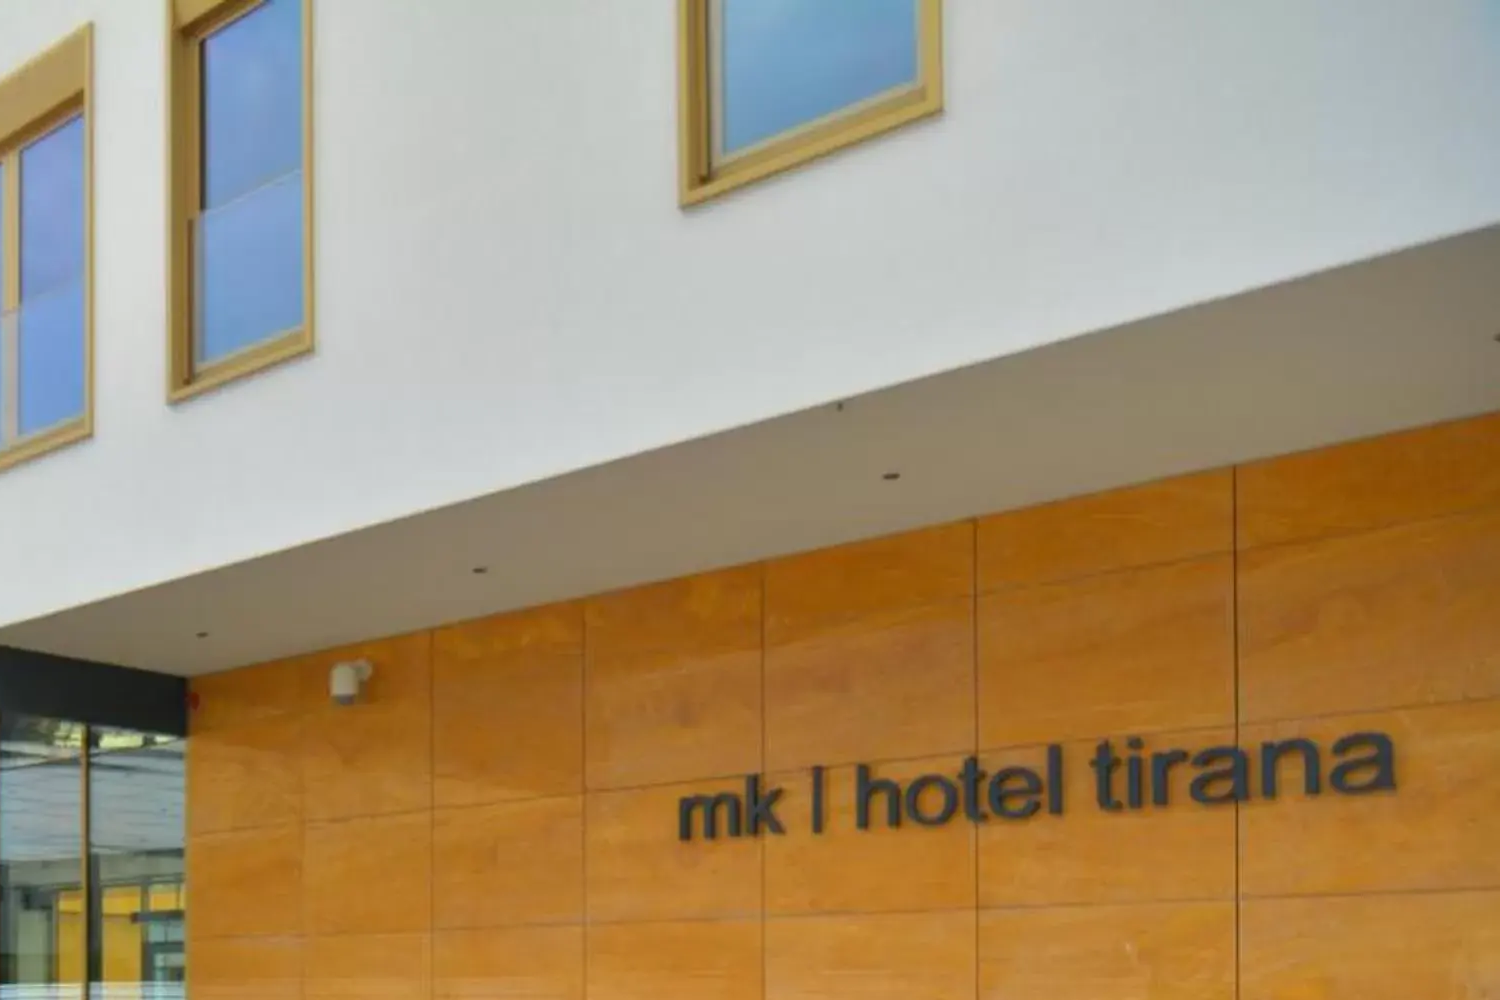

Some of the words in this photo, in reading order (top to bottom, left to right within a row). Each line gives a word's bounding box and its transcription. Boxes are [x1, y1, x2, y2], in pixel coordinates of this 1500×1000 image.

[678, 773, 785, 842] mk
[855, 743, 1065, 830] hotel
[1090, 731, 1398, 813] tirana
